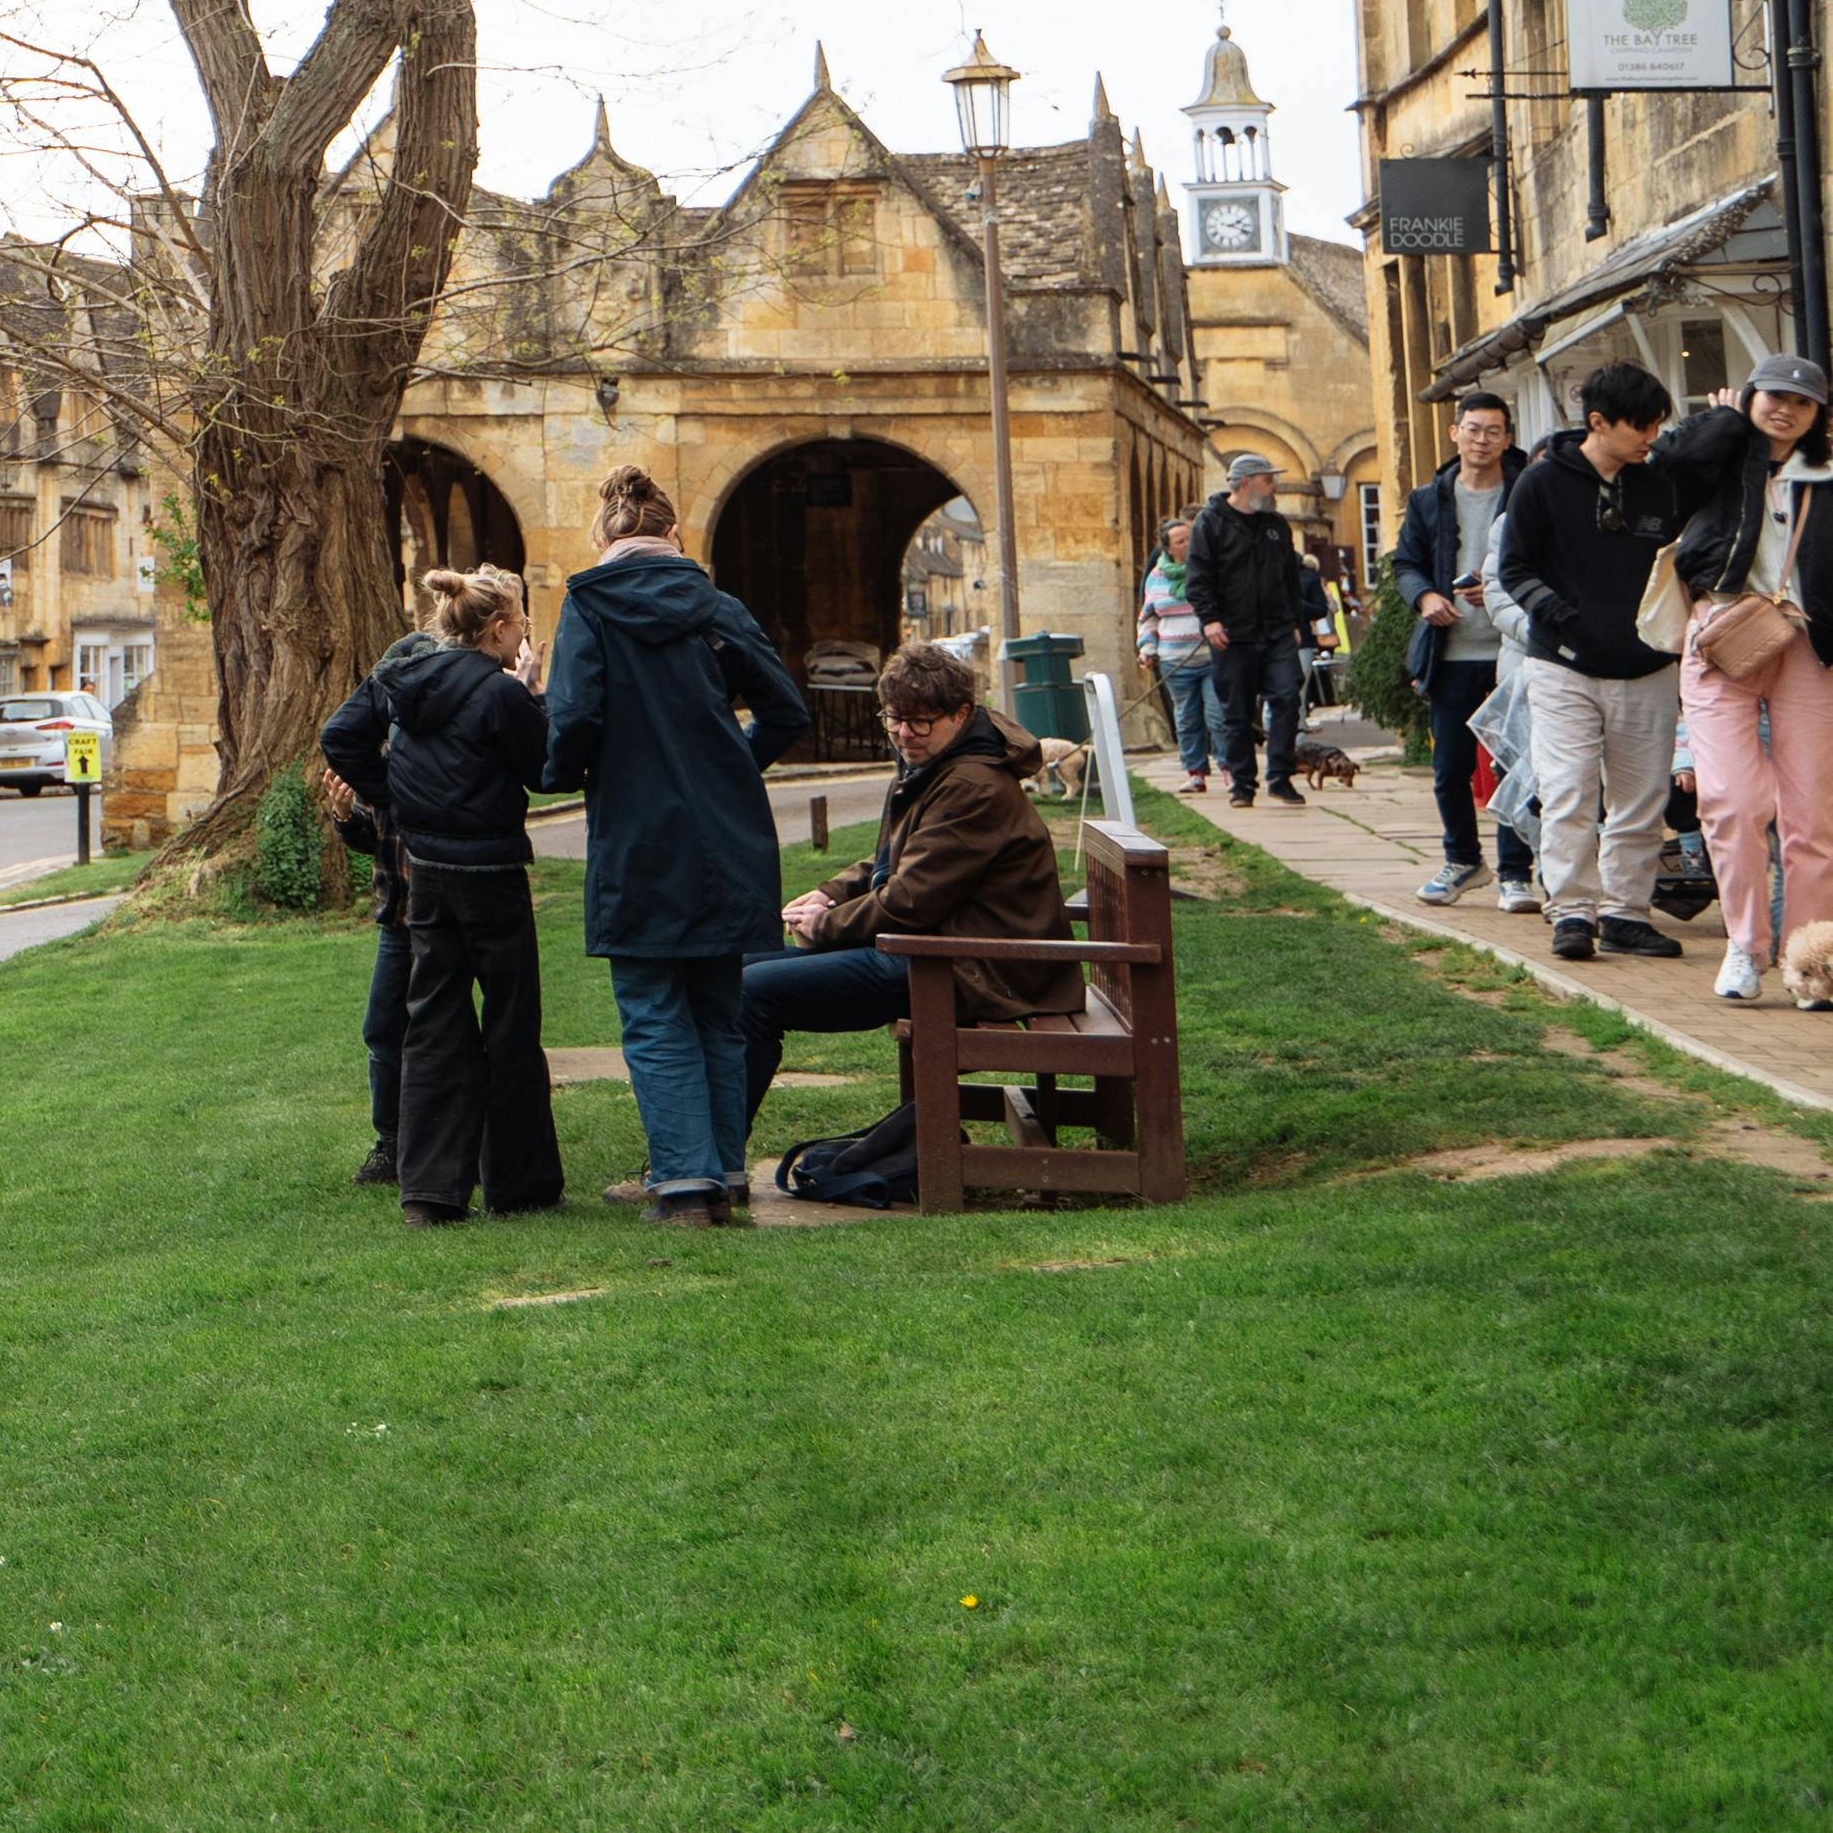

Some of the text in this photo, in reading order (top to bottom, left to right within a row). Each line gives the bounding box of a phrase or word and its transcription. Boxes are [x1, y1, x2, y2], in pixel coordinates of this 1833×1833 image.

[1603, 32, 1698, 46] THE BAY TREE
[1389, 216, 1463, 231] FRANKIE
[1389, 232, 1464, 247] DOODLE
[68, 738, 96, 746] CRAFT
